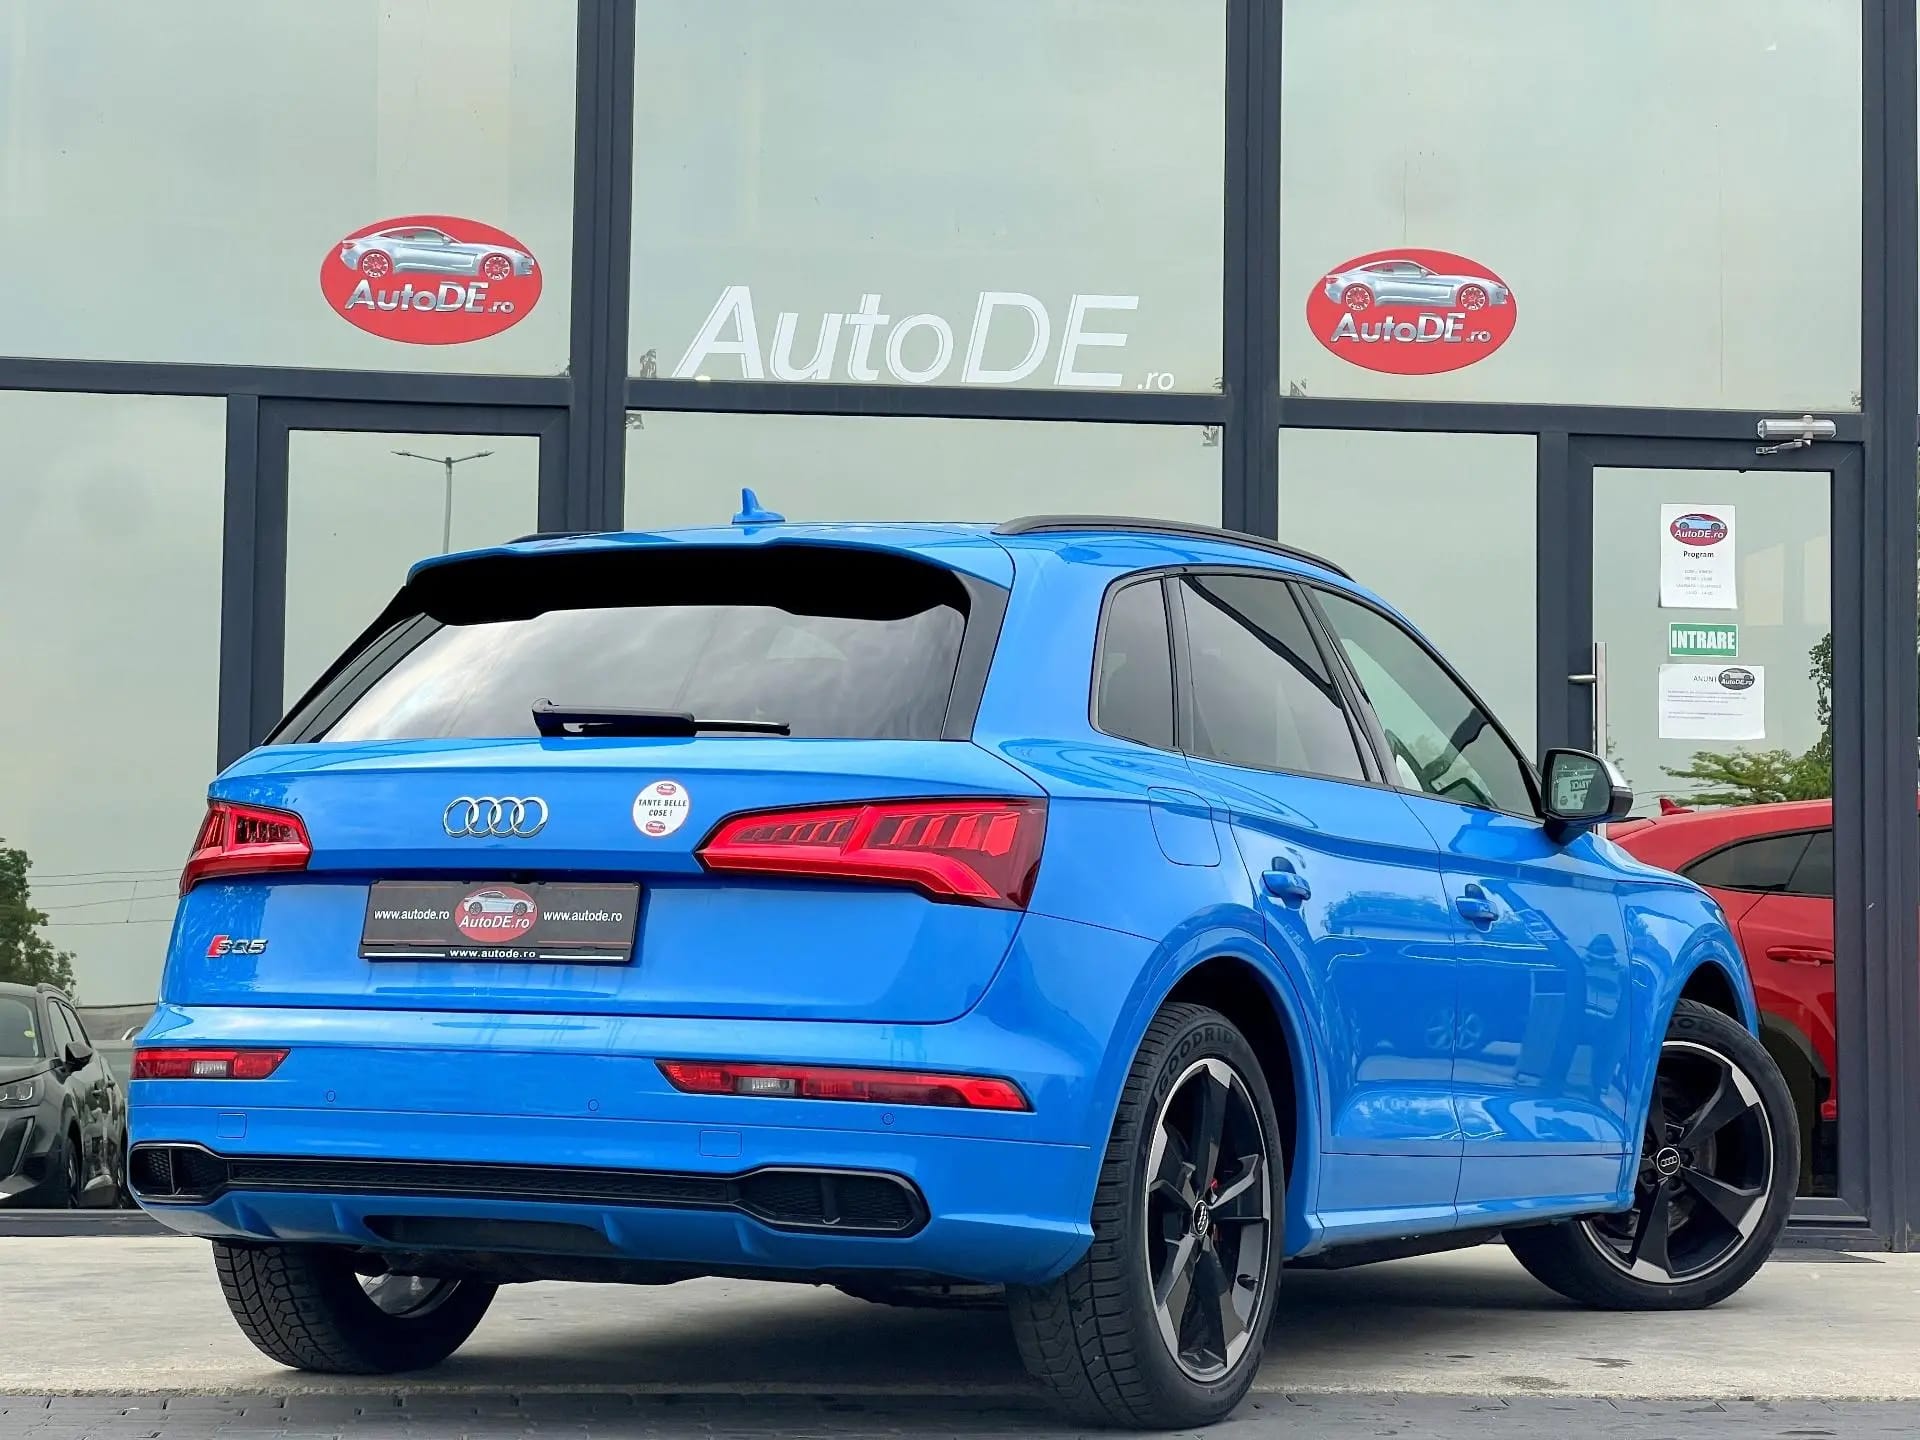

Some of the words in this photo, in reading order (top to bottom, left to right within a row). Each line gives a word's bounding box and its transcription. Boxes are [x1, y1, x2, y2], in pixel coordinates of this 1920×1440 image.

[1674, 530, 1724, 539] AutoDE.ro
[1683, 550, 1715, 559] Program
[1672, 630, 1735, 649] INTRARE
[638, 799, 662, 807] TANTE
[664, 799, 687, 807] BELLE
[648, 809, 667, 817] COSE
[374, 908, 450, 920] www.autode.ro
[543, 909, 623, 922] www.autode.ro
[458, 916, 530, 929] AutoDE.ro
[215, 938, 268, 955] SQ5
[449, 949, 536, 959] www.autode.ro
